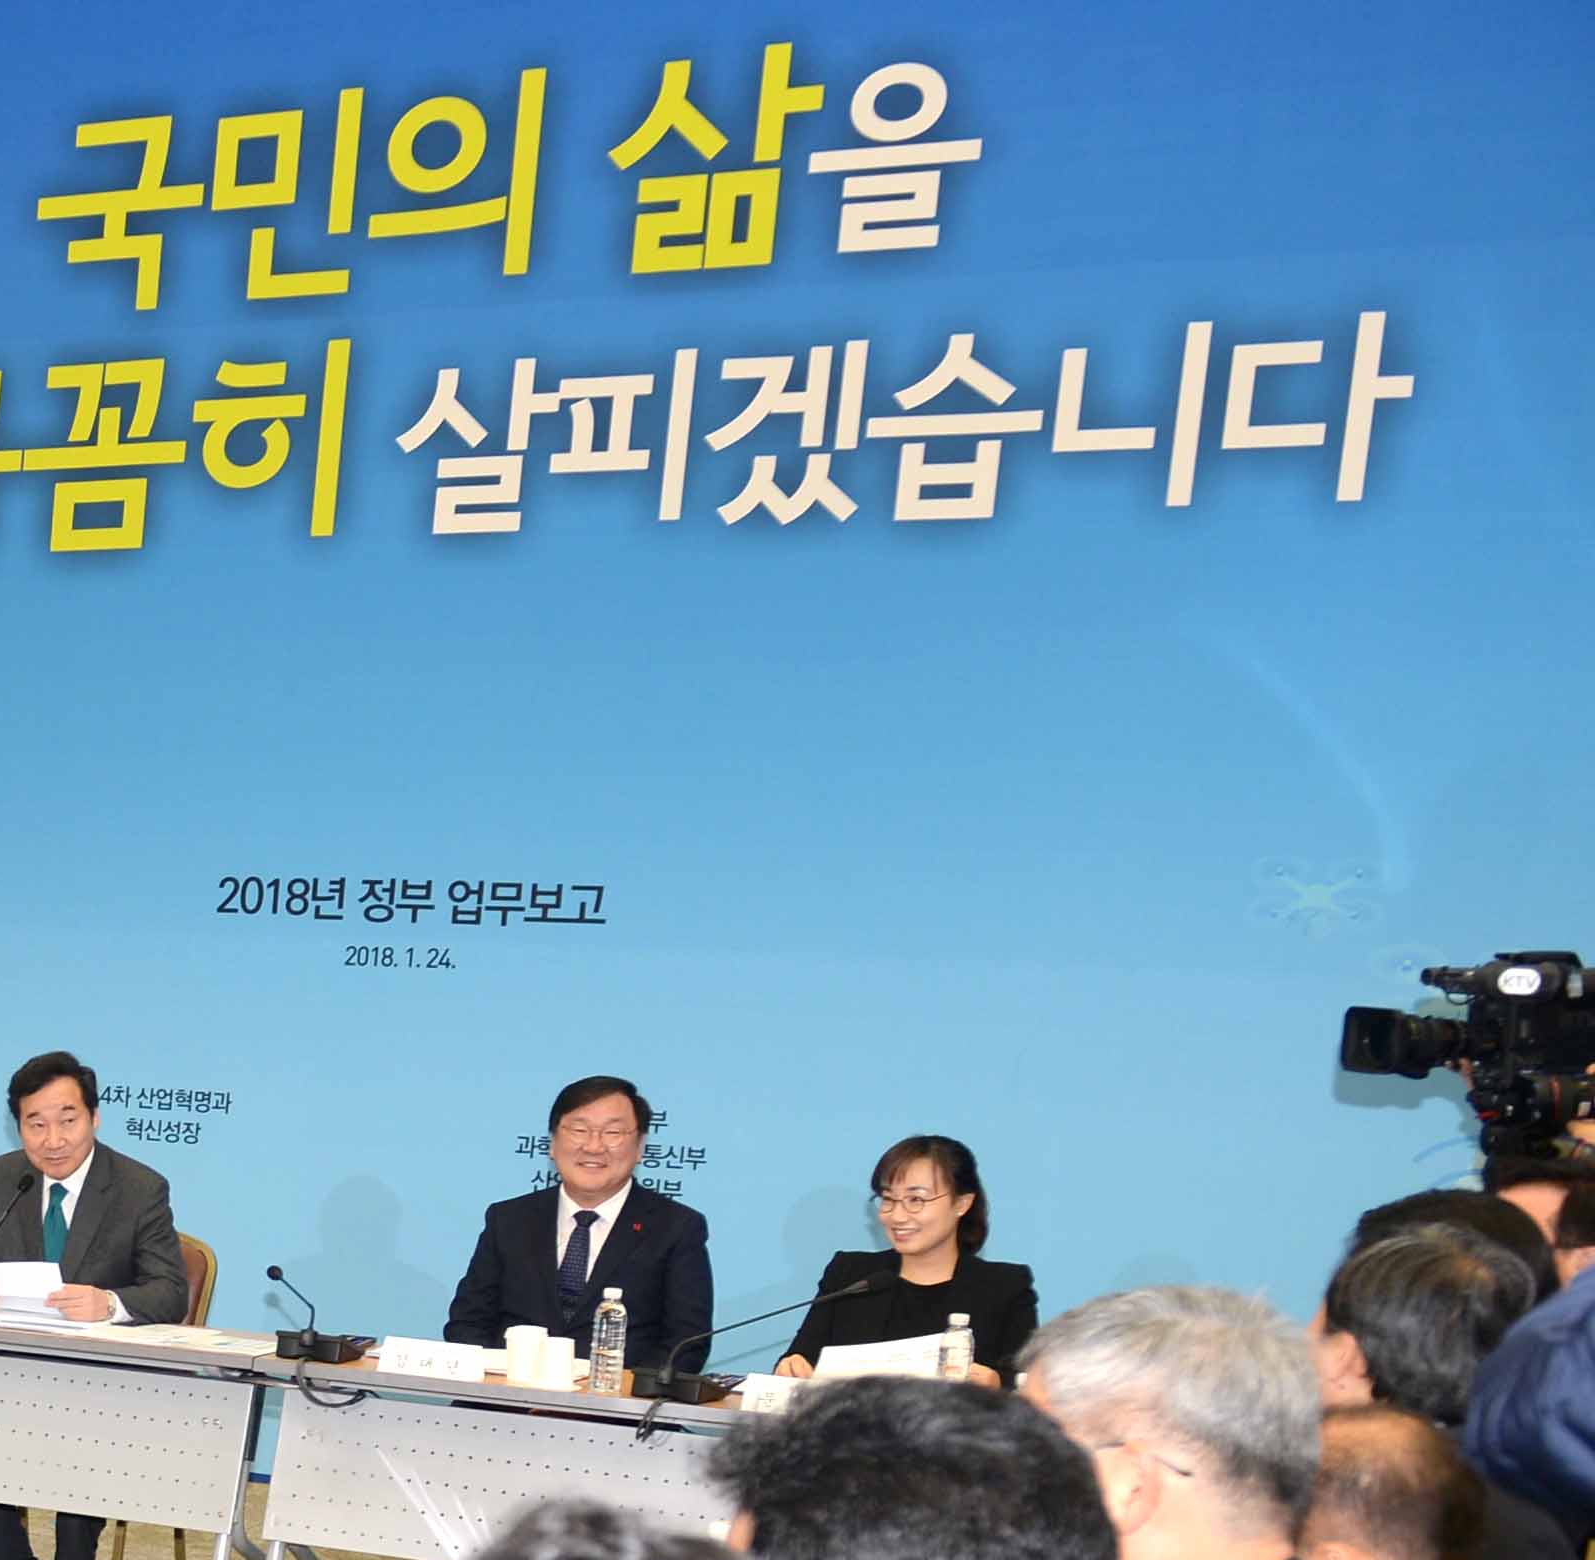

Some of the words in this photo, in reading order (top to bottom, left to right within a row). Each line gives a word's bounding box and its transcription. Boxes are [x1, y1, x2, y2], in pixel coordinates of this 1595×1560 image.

[37, 69, 547, 310] 국민의
[609, 43, 982, 274] 삶을
[396, 311, 1414, 535] 살피겠습니다
[216, 876, 347, 921] 2018년
[357, 877, 436, 924] 정부
[447, 879, 607, 927] 업무보고
[344, 945, 398, 968] 2018.
[425, 947, 456, 969] 24.
[1503, 975, 1539, 990] KTV
[136, 1087, 233, 1115] 산업혁명과
[126, 1117, 202, 1145] 혁신성장
